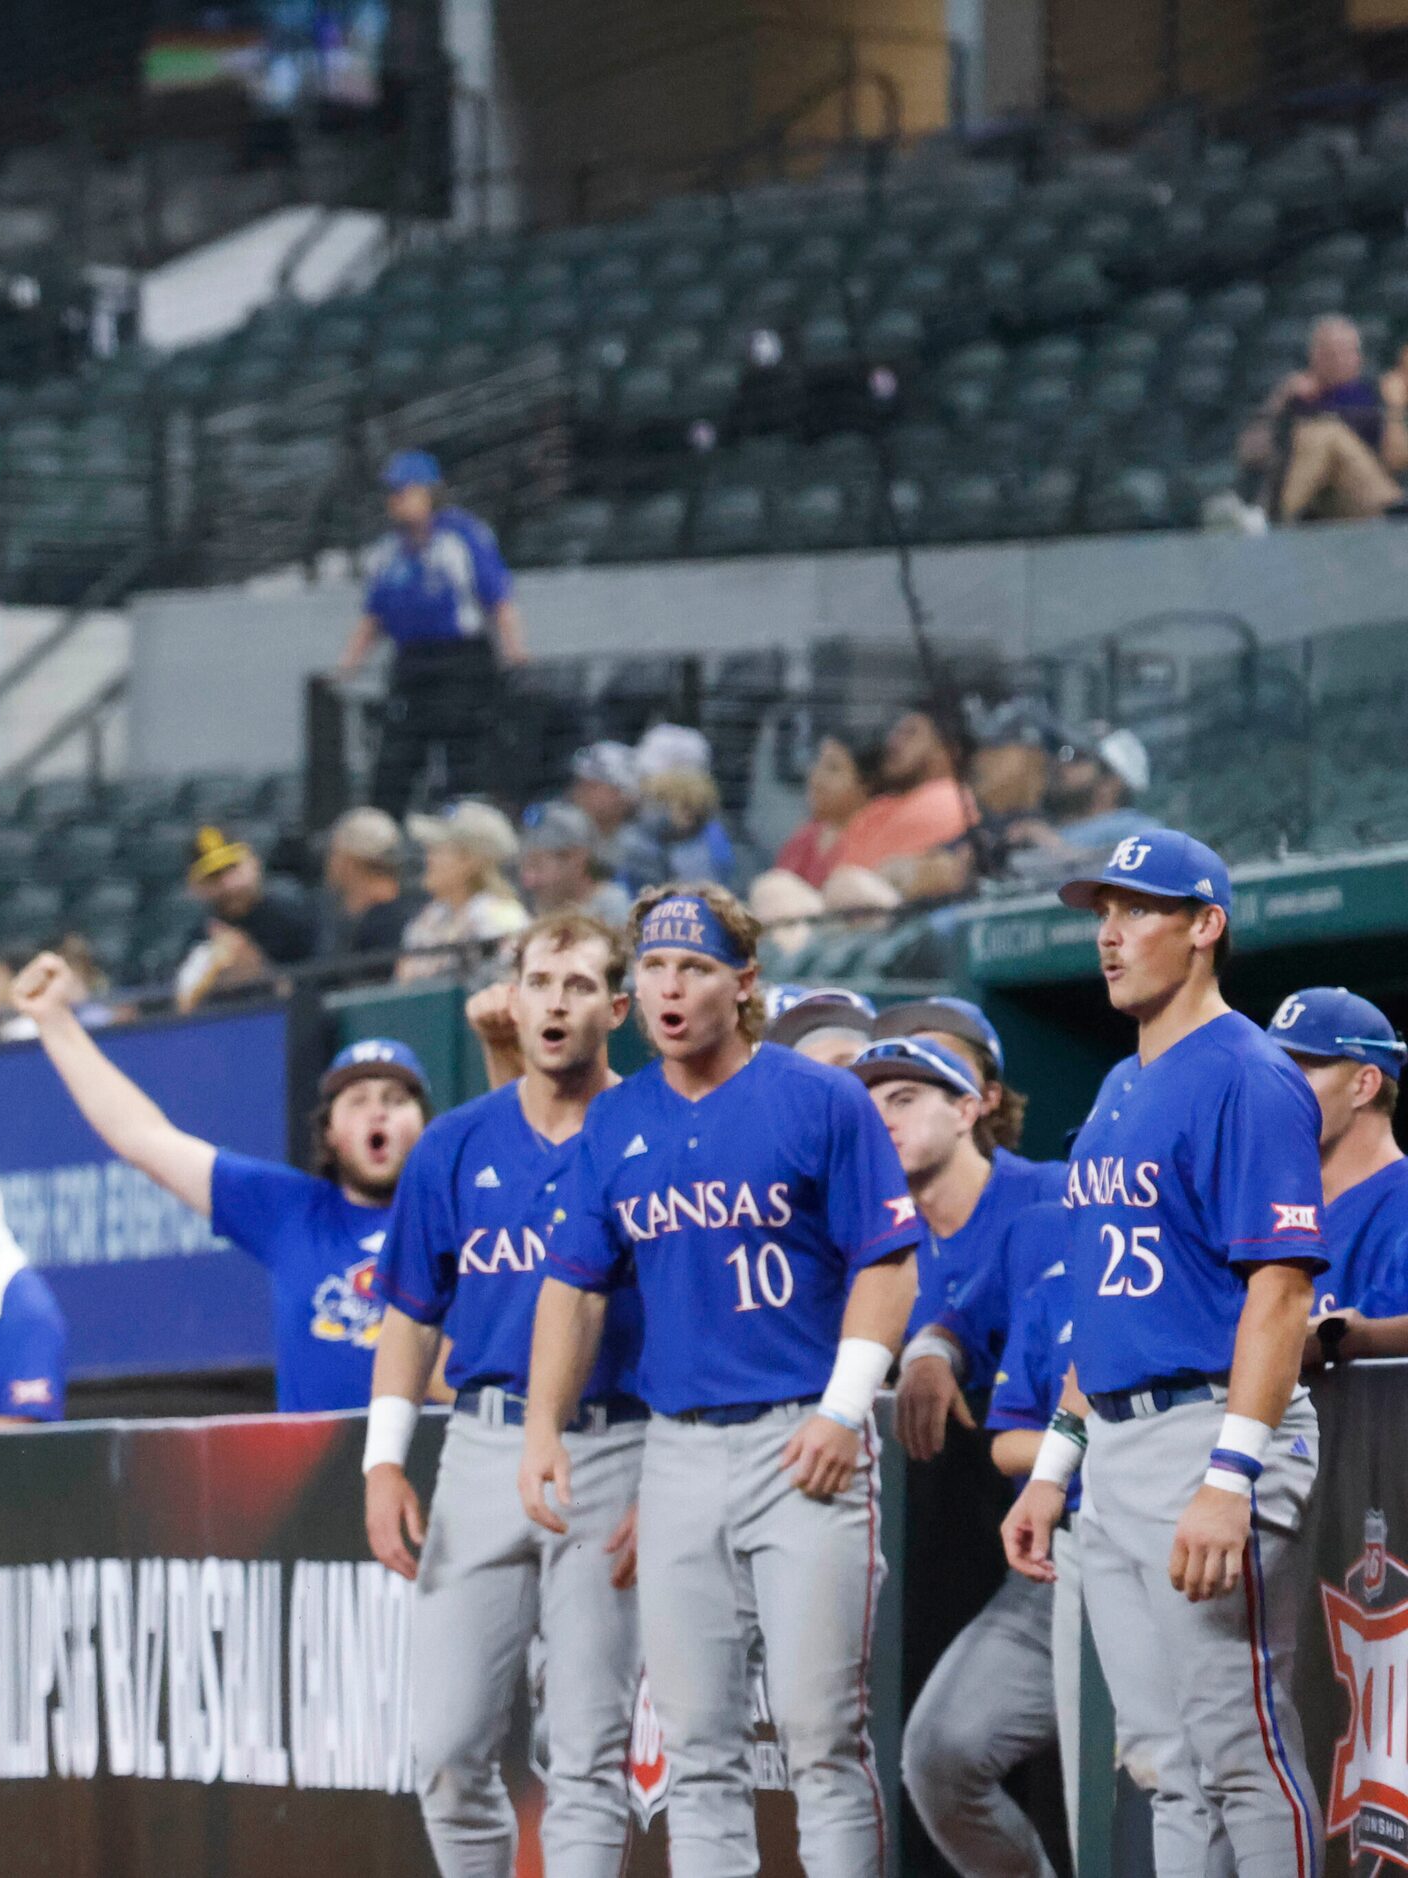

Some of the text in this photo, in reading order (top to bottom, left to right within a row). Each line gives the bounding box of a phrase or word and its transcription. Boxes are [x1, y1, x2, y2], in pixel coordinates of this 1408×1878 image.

[642, 919, 706, 944] CHALK
[651, 901, 700, 920] ROCK
[1063, 1156, 1160, 1208] ANSAS
[615, 1180, 792, 1242] KANSAS
[458, 1226, 547, 1274] KAN
[1098, 1223, 1164, 1297] 25
[726, 1241, 794, 1312] 10
